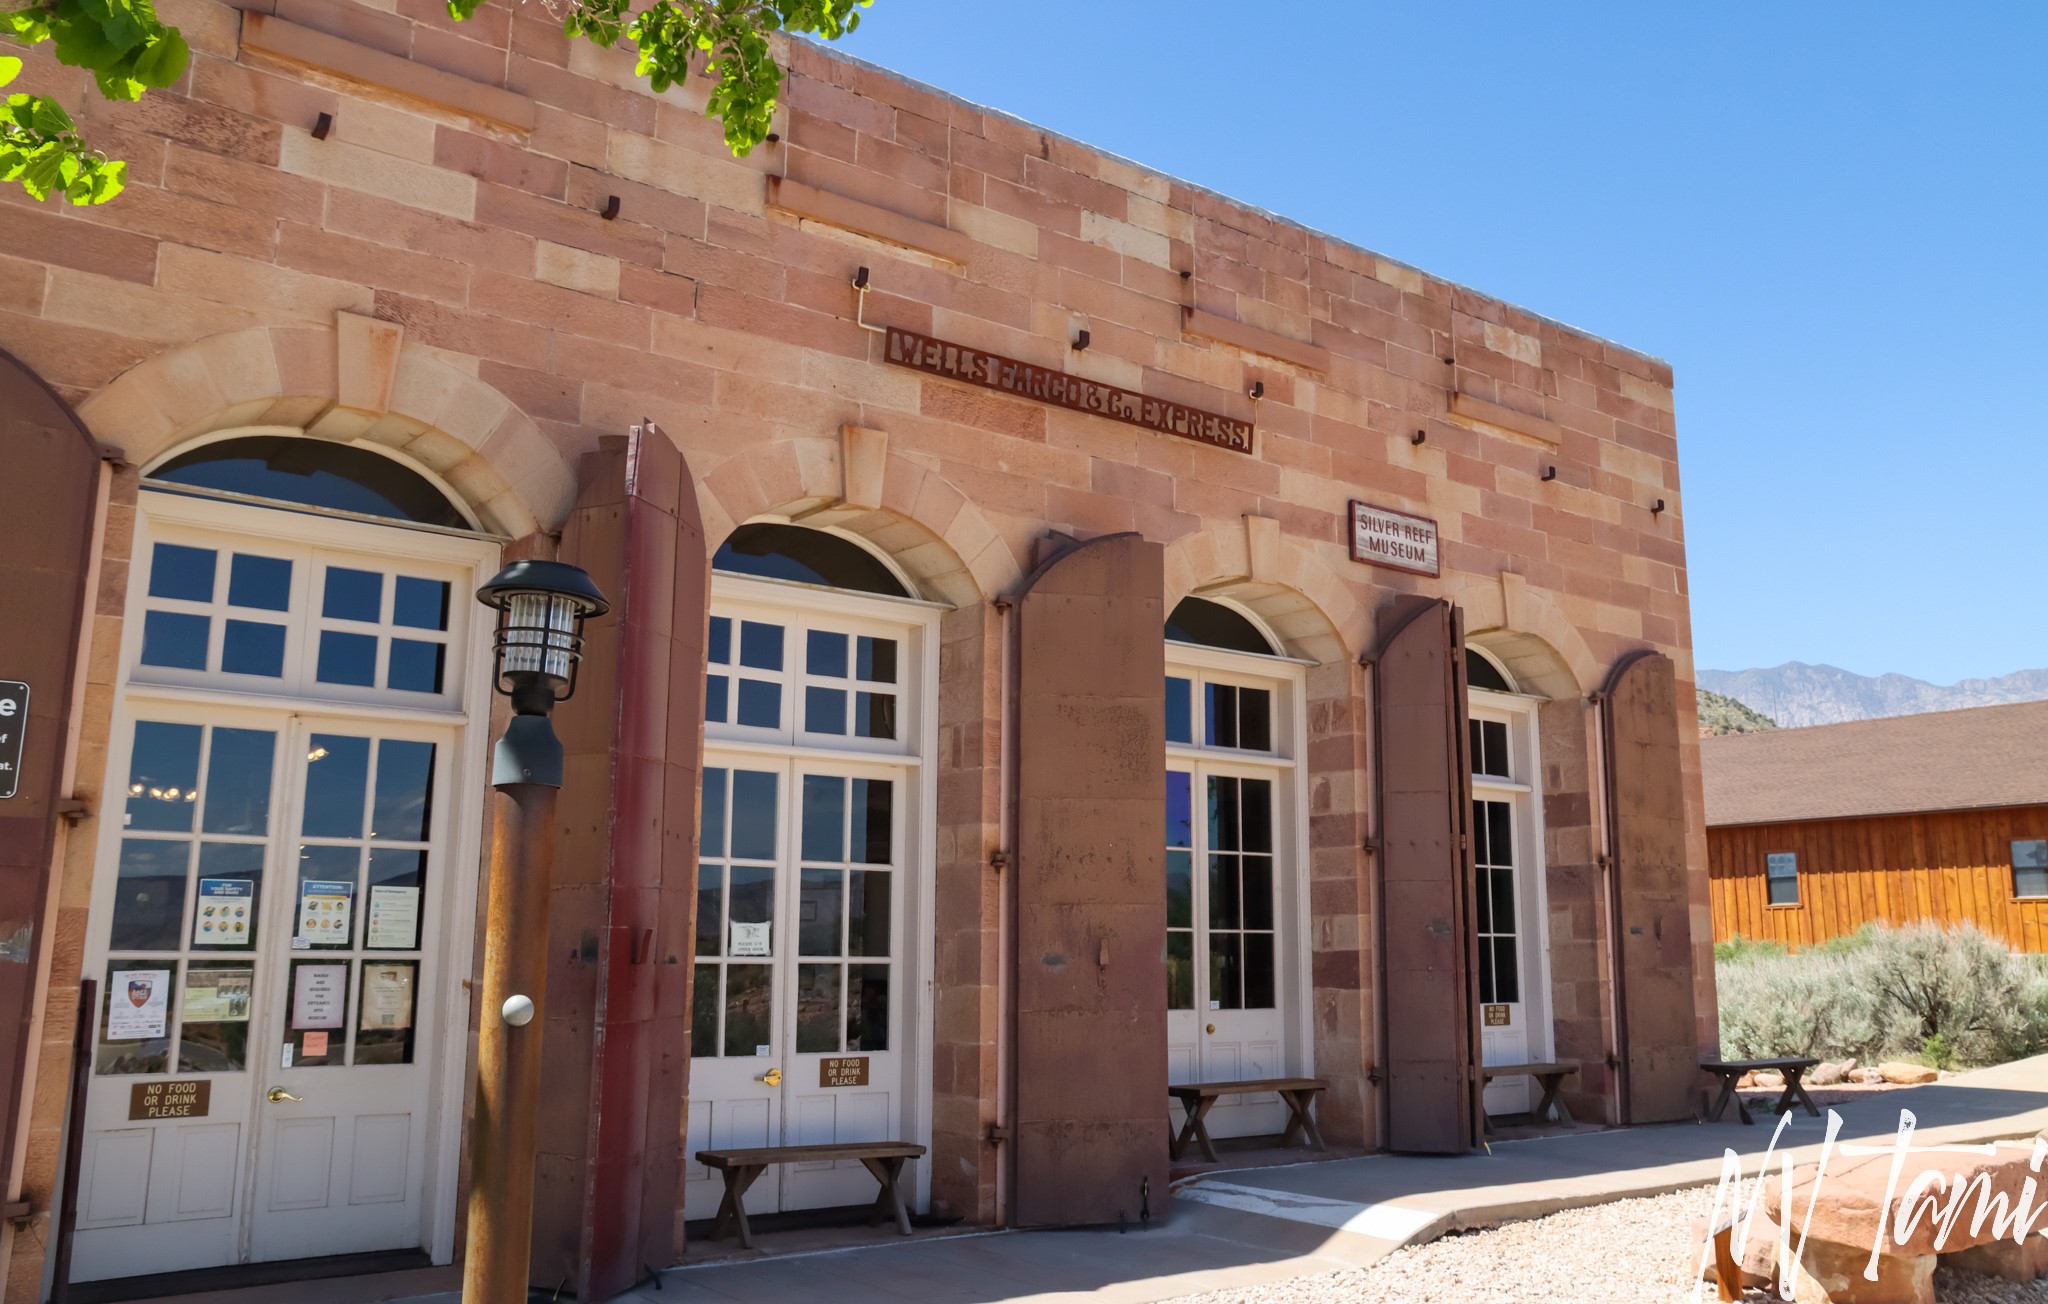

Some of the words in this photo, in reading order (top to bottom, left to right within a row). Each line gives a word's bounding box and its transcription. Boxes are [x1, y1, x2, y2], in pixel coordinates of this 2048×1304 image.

[894, 333, 989, 385] WELLS
[999, 360, 1081, 407] FARGO
[1141, 398, 1247, 450] EXPRESS
[1360, 514, 1400, 538] SILVER
[1404, 524, 1432, 545] REEF
[1368, 535, 1425, 563] MUSEUM
[829, 1060, 839, 1068] NO
[842, 1059, 860, 1067] FOOD
[828, 1068, 837, 1077] OR
[840, 1067, 861, 1076] DRINK
[831, 1076, 857, 1086] PLEASE
[147, 1084, 162, 1095] NO
[168, 1082, 197, 1094] FOOD
[143, 1095, 159, 1106] OR
[164, 1094, 197, 1105] DRINK
[148, 1105, 191, 1117] PLEASE
